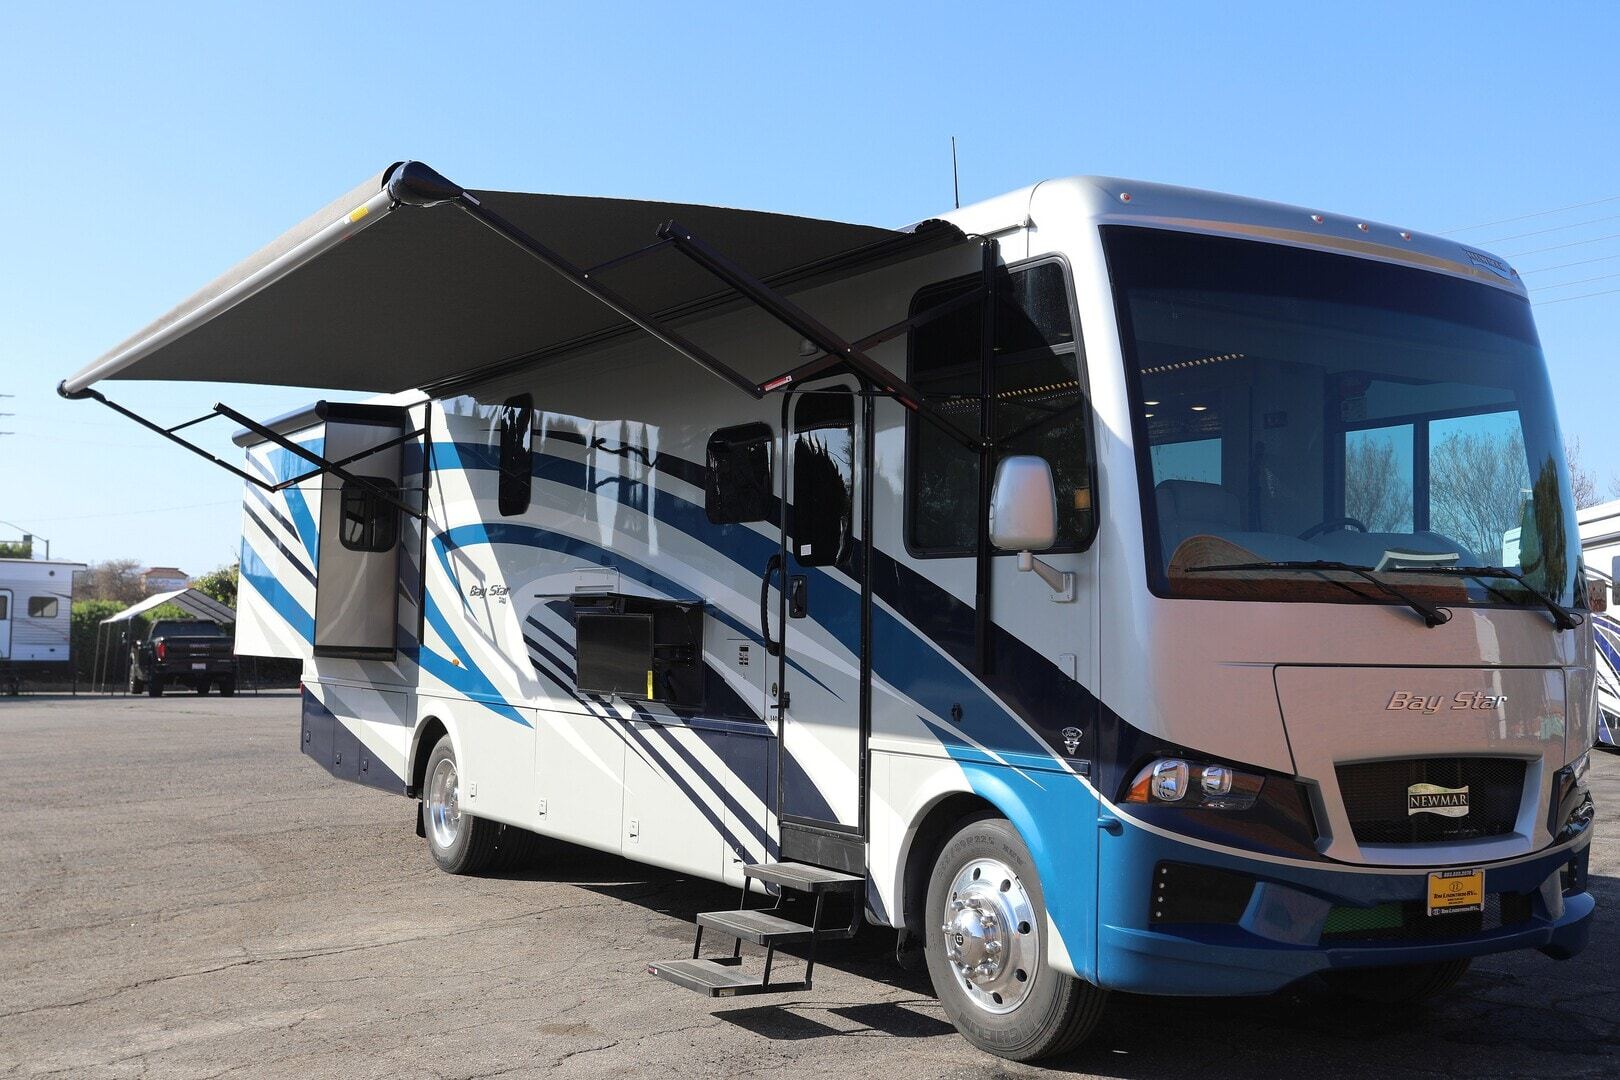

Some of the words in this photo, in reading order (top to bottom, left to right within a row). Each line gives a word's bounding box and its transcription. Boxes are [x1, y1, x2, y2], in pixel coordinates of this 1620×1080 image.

[470, 585, 488, 599] Bay
[489, 585, 512, 597] Star
[1385, 690, 1444, 715] Bay
[1450, 690, 1508, 710] Star
[1410, 794, 1467, 808] NEWMAR
